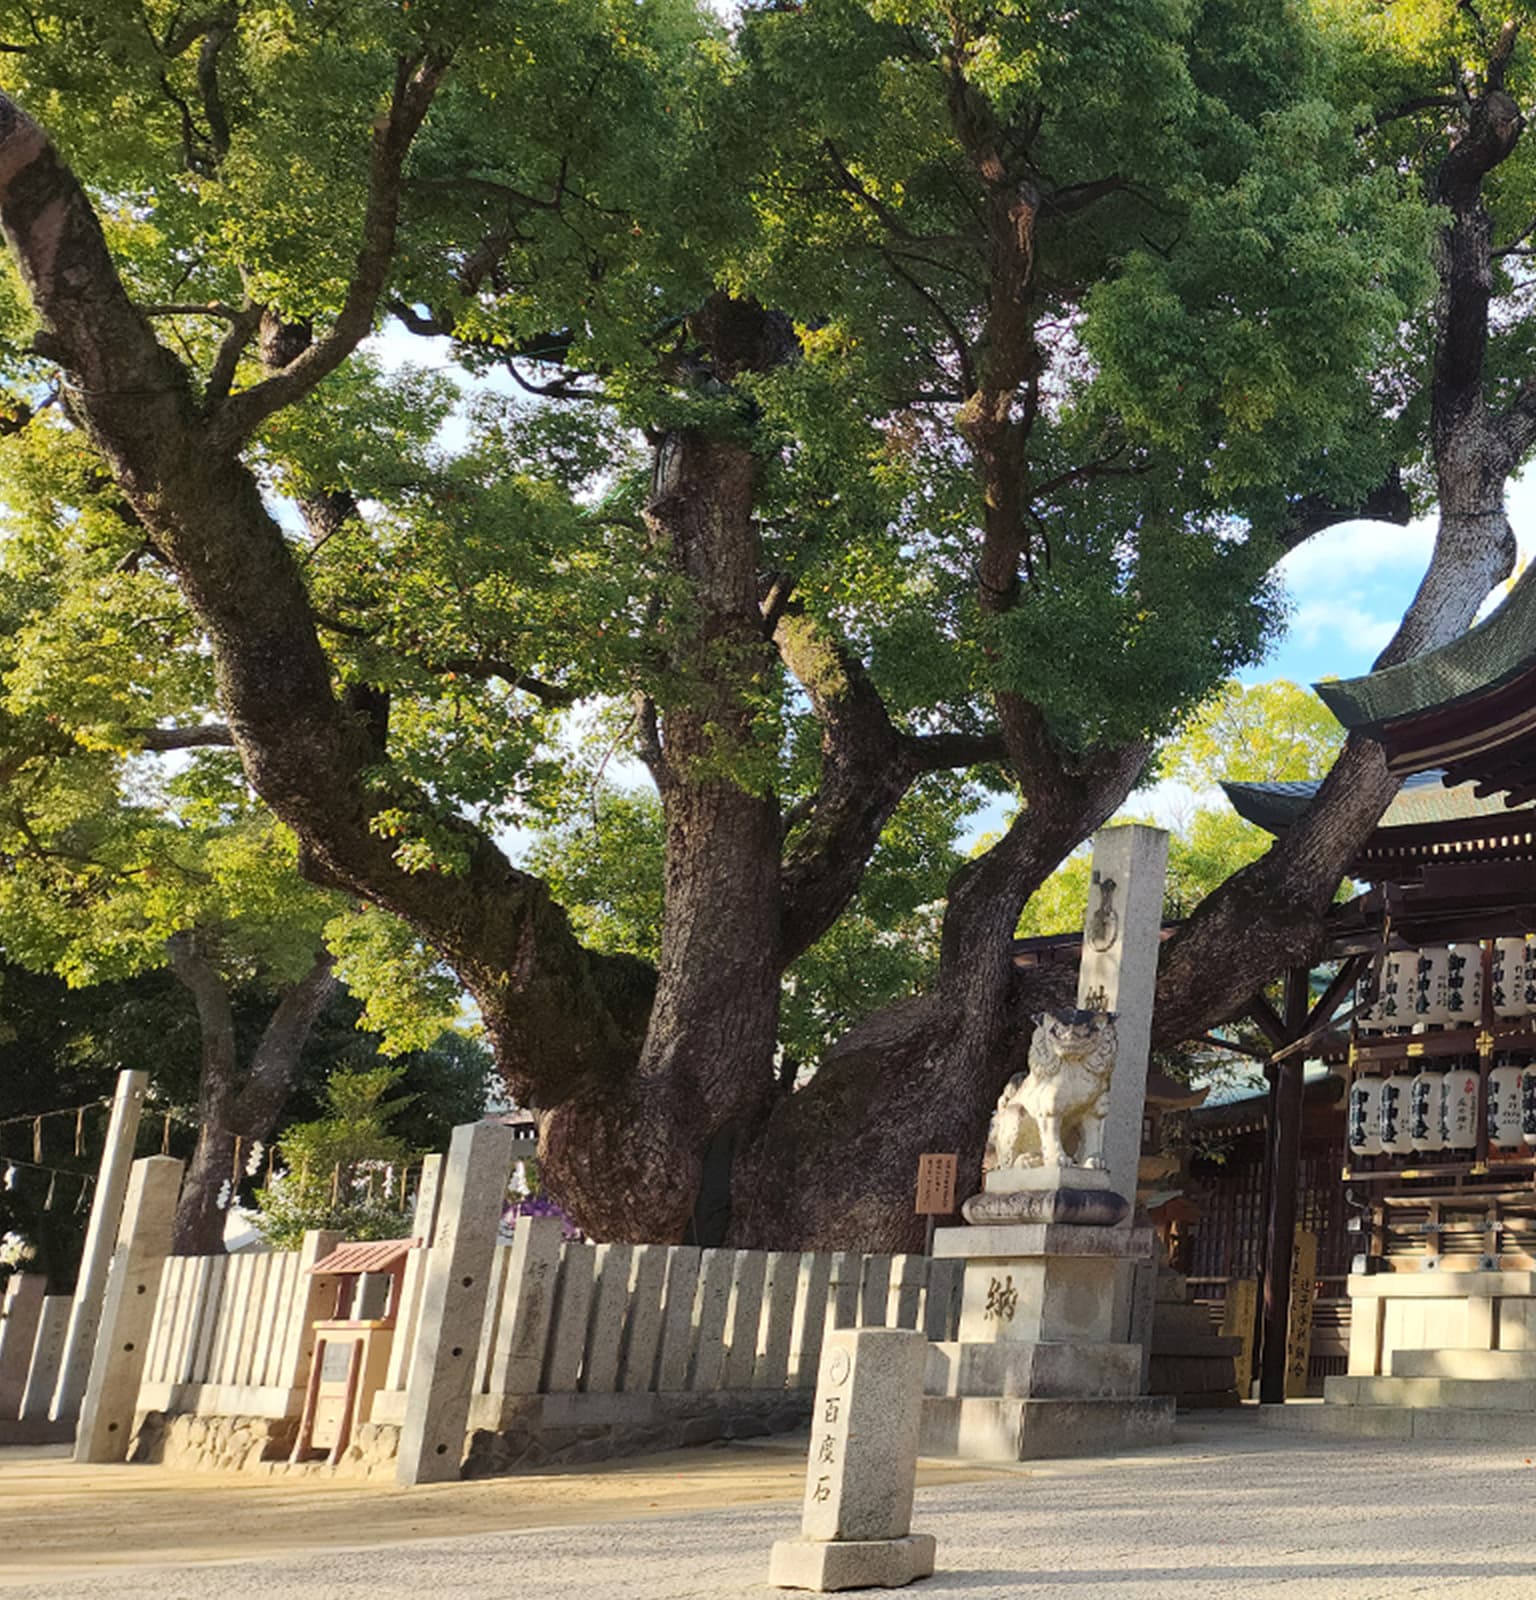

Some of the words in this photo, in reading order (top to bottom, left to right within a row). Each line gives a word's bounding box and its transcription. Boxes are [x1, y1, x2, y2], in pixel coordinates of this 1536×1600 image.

[984, 1274, 1018, 1322] 納
[812, 1396, 841, 1504] 百度石
